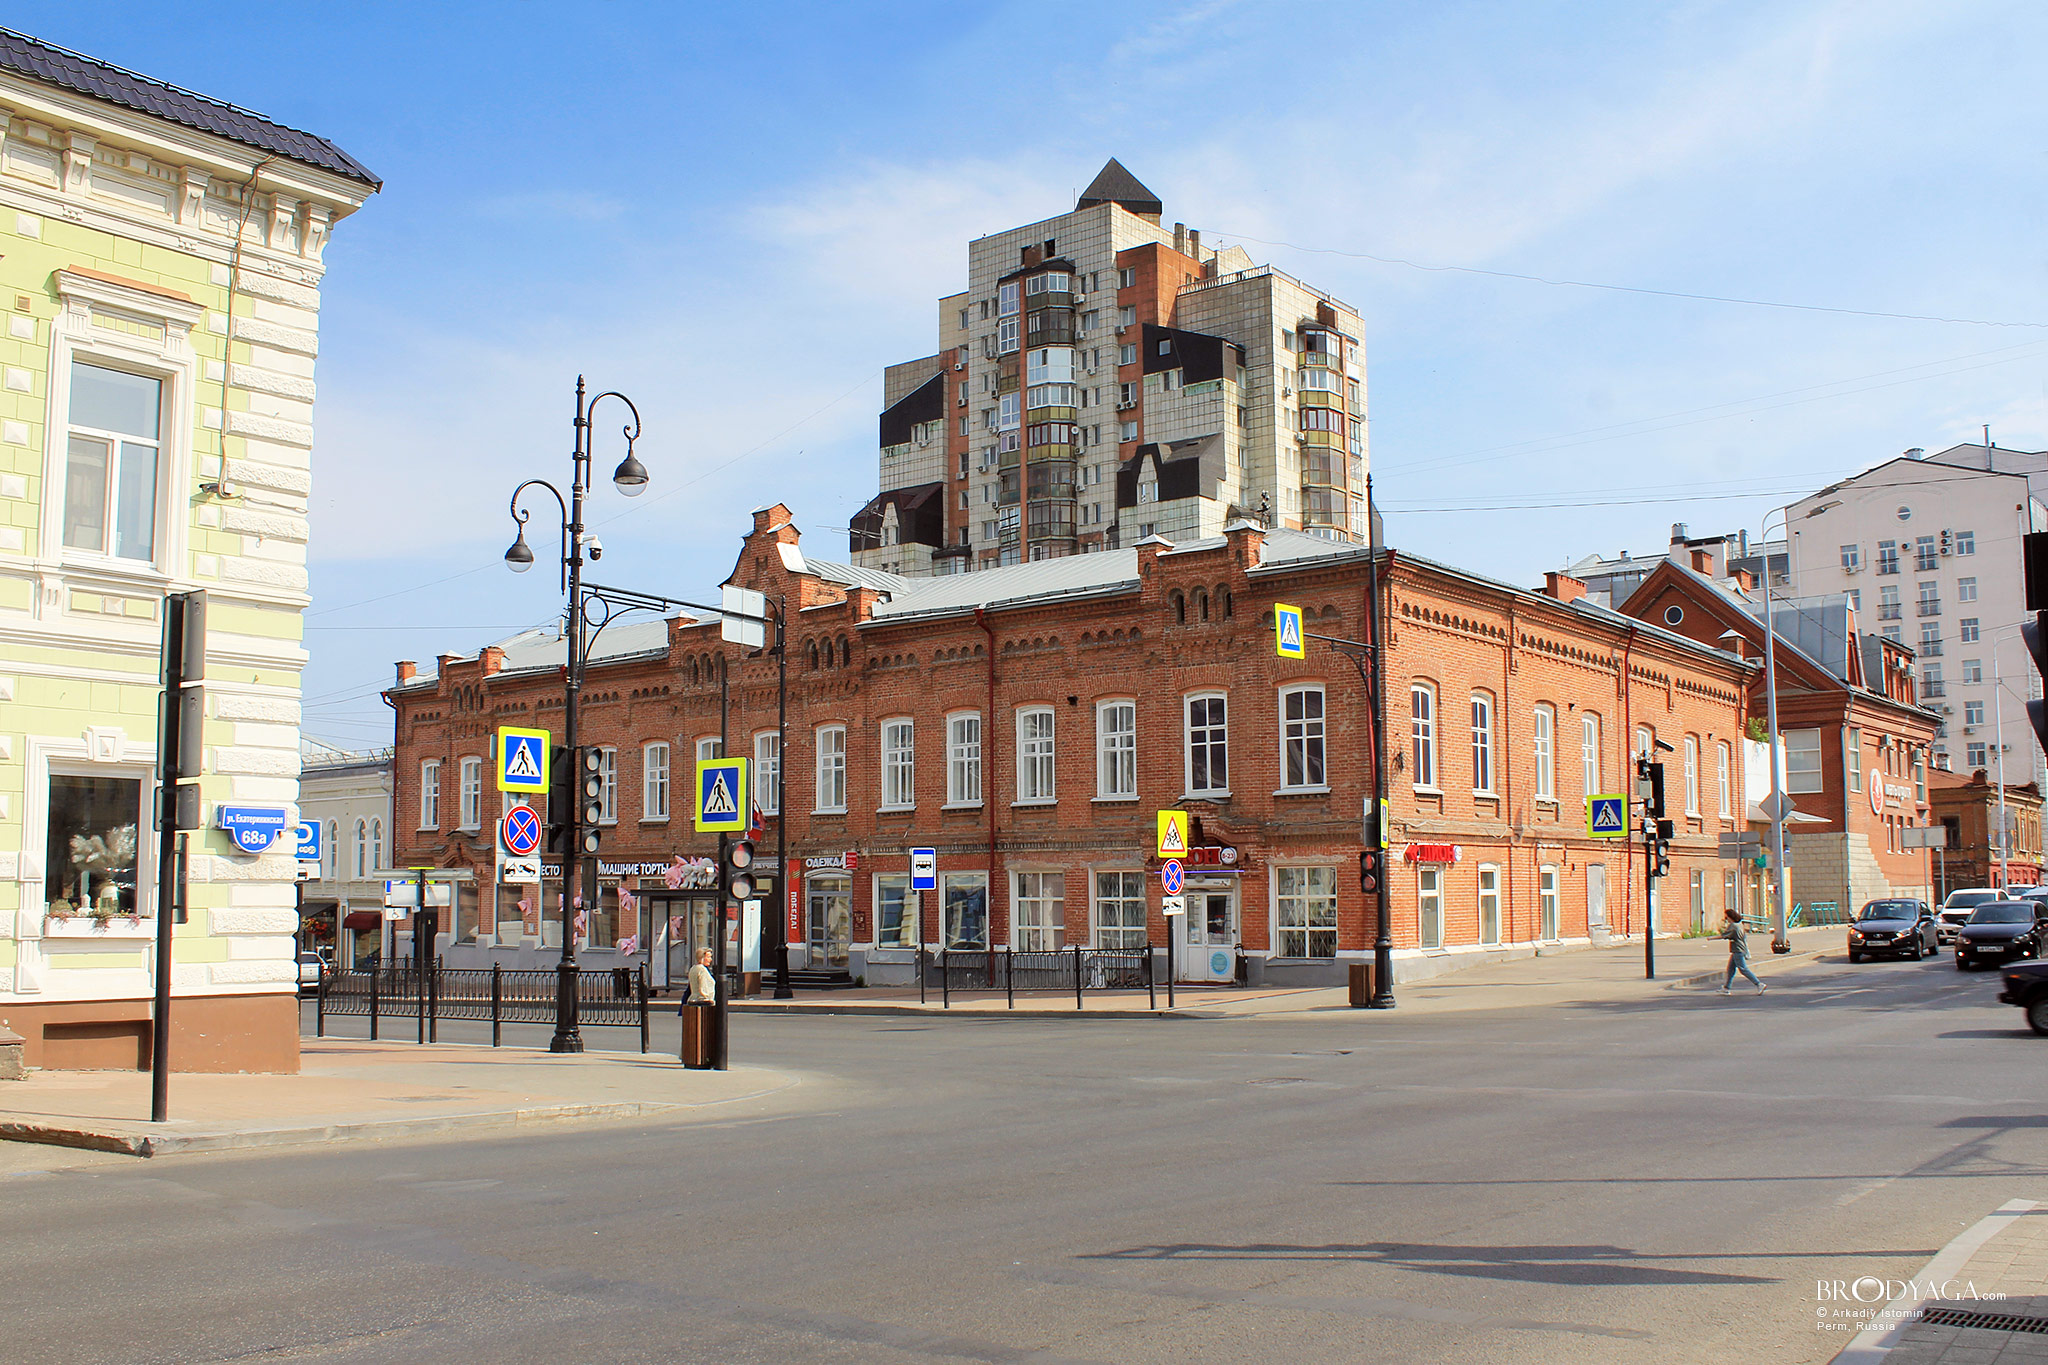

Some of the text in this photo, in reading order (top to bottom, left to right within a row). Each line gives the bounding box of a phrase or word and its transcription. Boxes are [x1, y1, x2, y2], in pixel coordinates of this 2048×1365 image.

[227, 815, 235, 824] ул.
[242, 830, 267, 844] 68а
[805, 857, 845, 868] ОДЕЖДА
[541, 864, 560, 876] ЕСТО
[598, 863, 670, 875] МАШНИЕ ТОРТЫ
[790, 891, 798, 930] ПОБЕДА!
